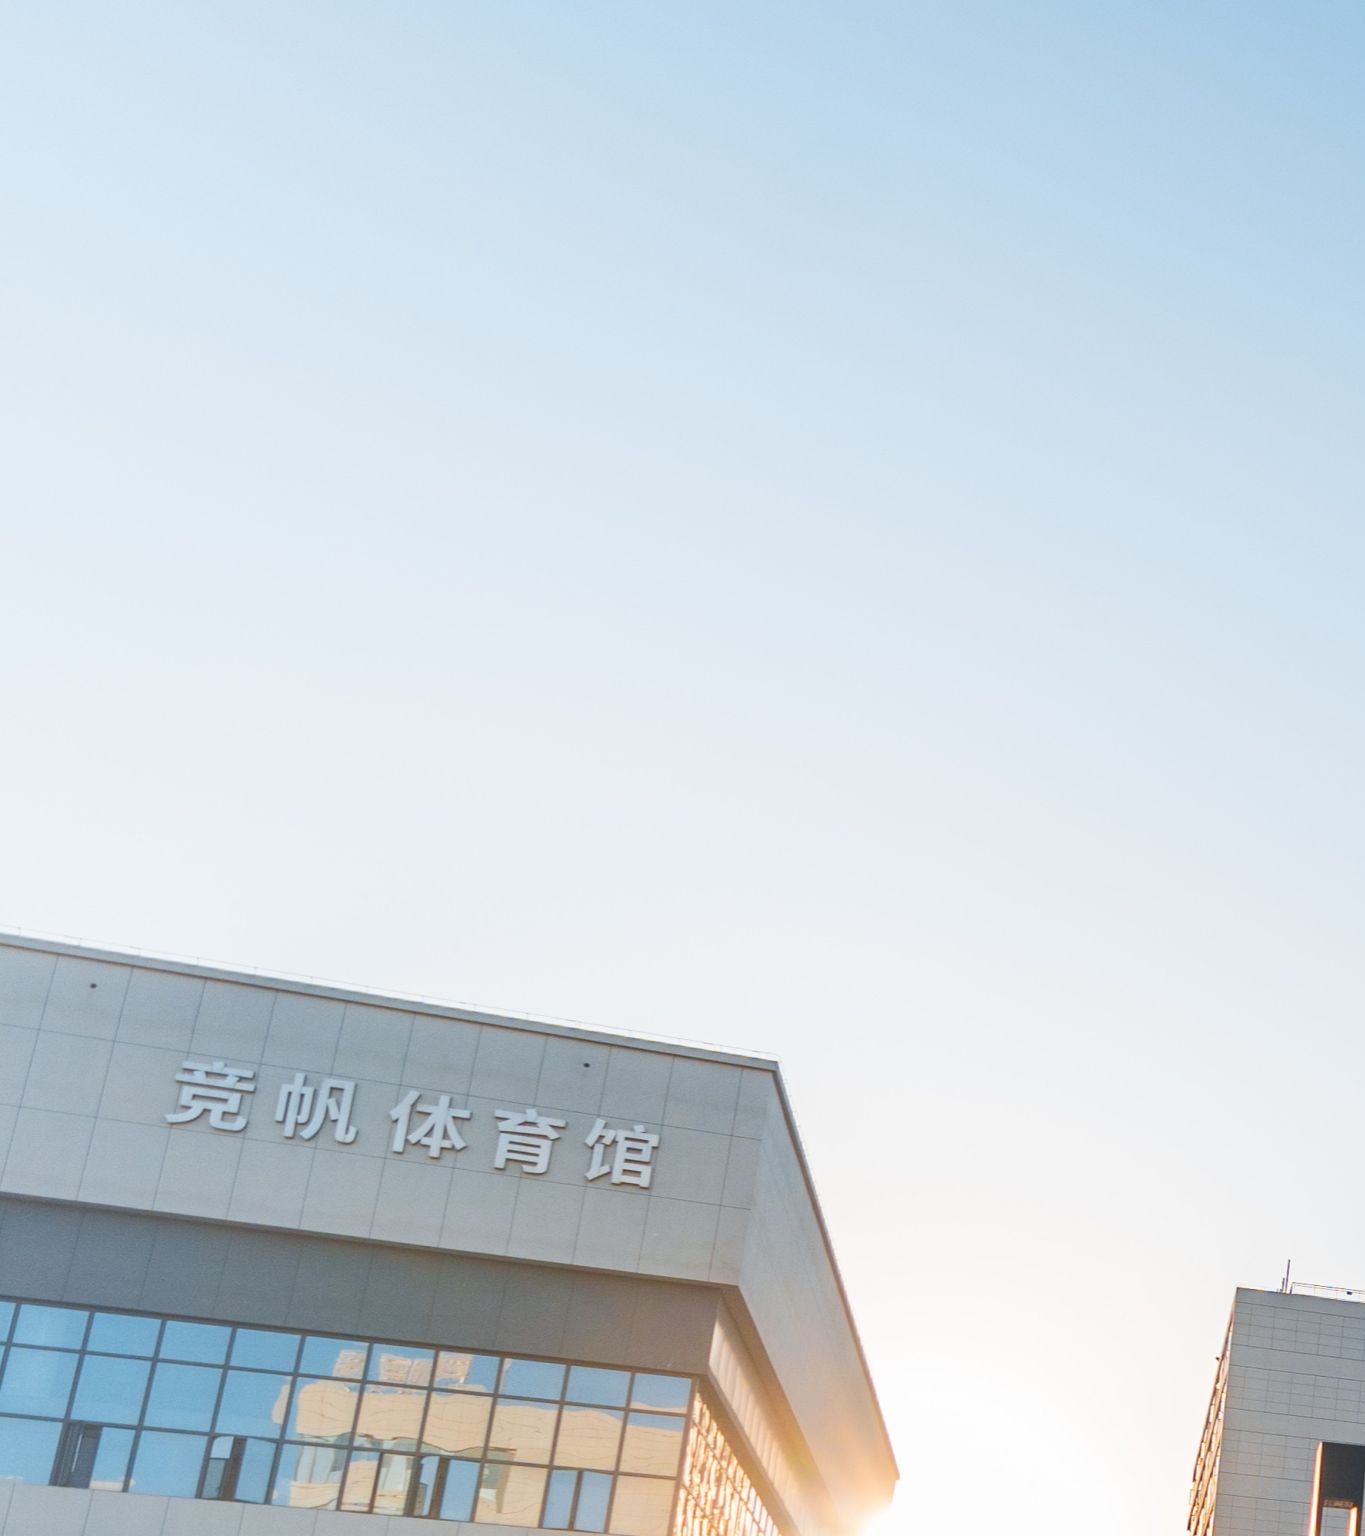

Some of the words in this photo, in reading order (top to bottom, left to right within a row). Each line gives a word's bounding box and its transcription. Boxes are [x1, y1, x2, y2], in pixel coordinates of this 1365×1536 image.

[165, 1061, 661, 1189] 竞帆体育馆
